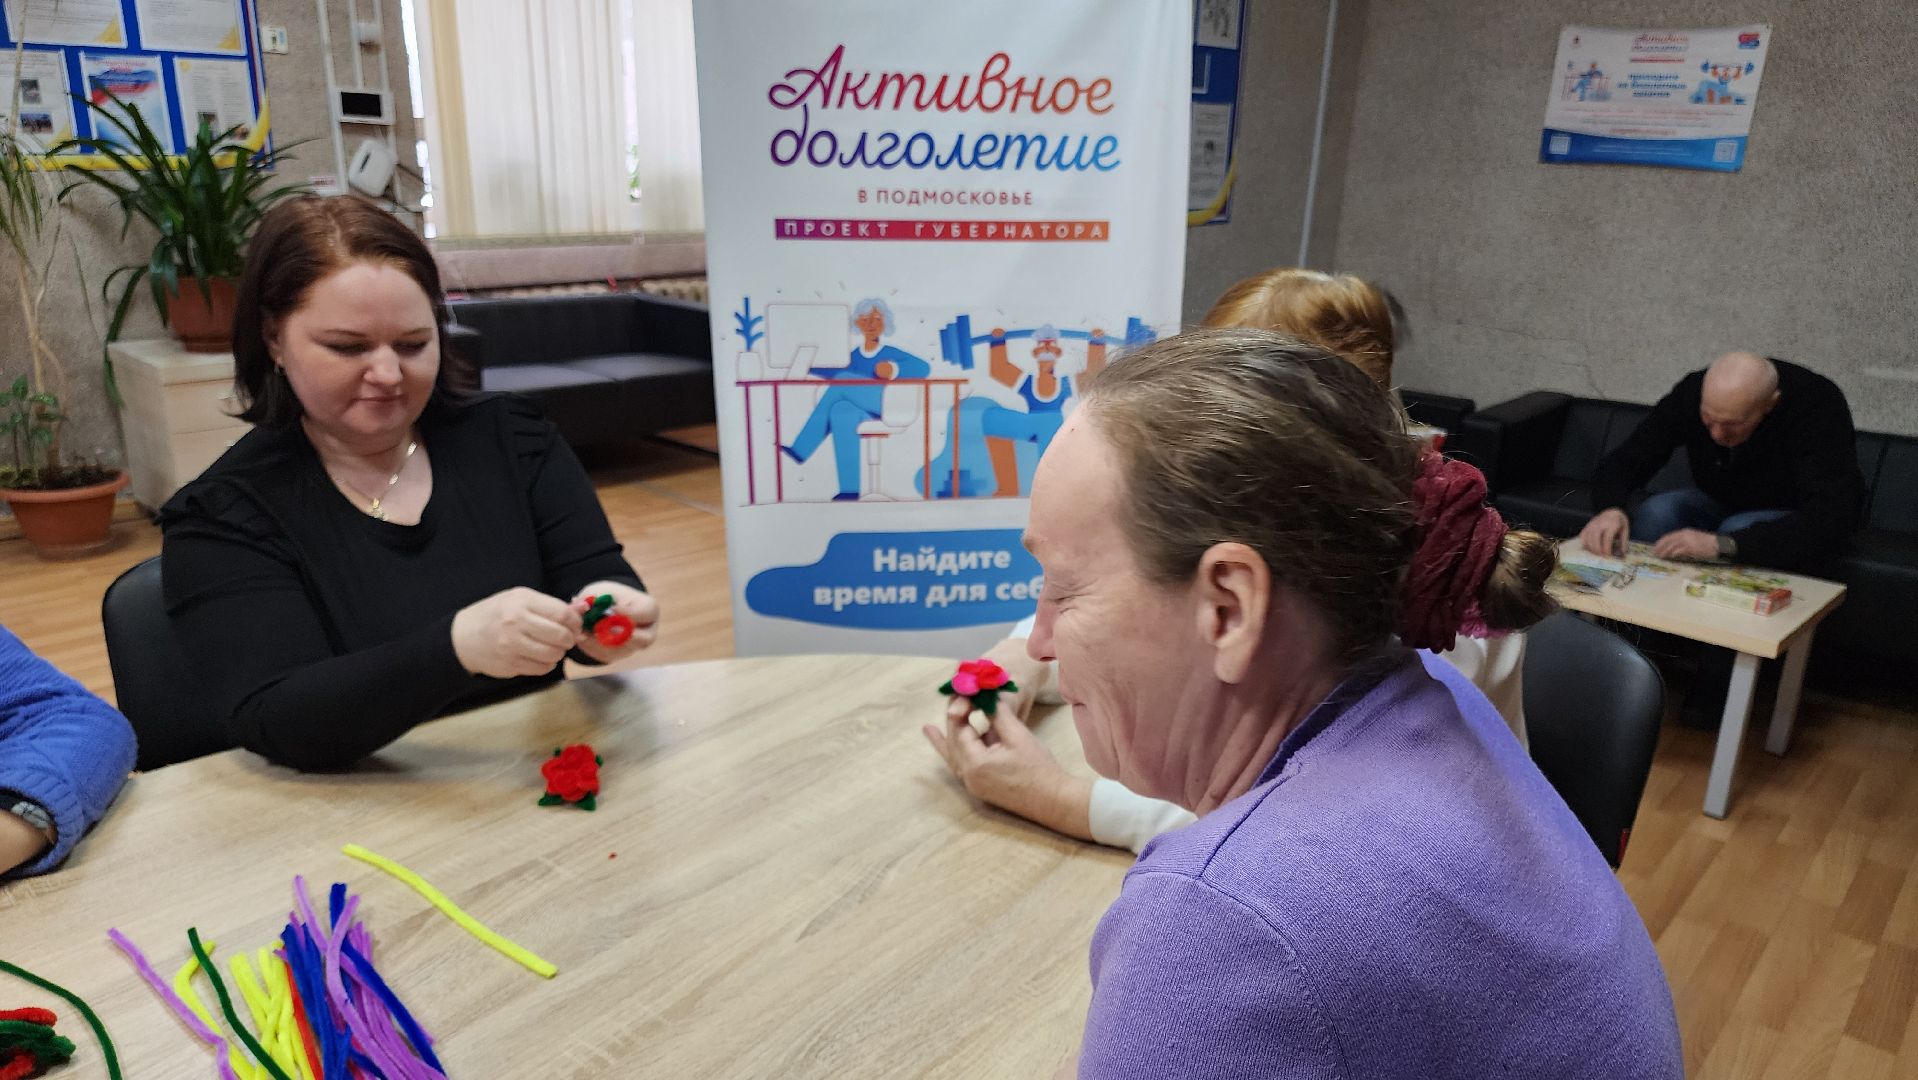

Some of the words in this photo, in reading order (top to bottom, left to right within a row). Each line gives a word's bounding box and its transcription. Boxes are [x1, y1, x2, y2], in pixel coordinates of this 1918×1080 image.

[768, 44, 1115, 114] Активное
[770, 103, 1121, 172] долголетие
[858, 189, 868, 204] В
[877, 189, 1033, 206] ПОДМОСКОВЬЕ
[785, 221, 889, 237] ПРОЕКТ
[914, 222, 1103, 239] ГУБЕРНАТОРА
[873, 547, 1011, 575] Найдите
[813, 586, 917, 612] время
[925, 583, 987, 607] для
[996, 575, 1045, 601] себ
